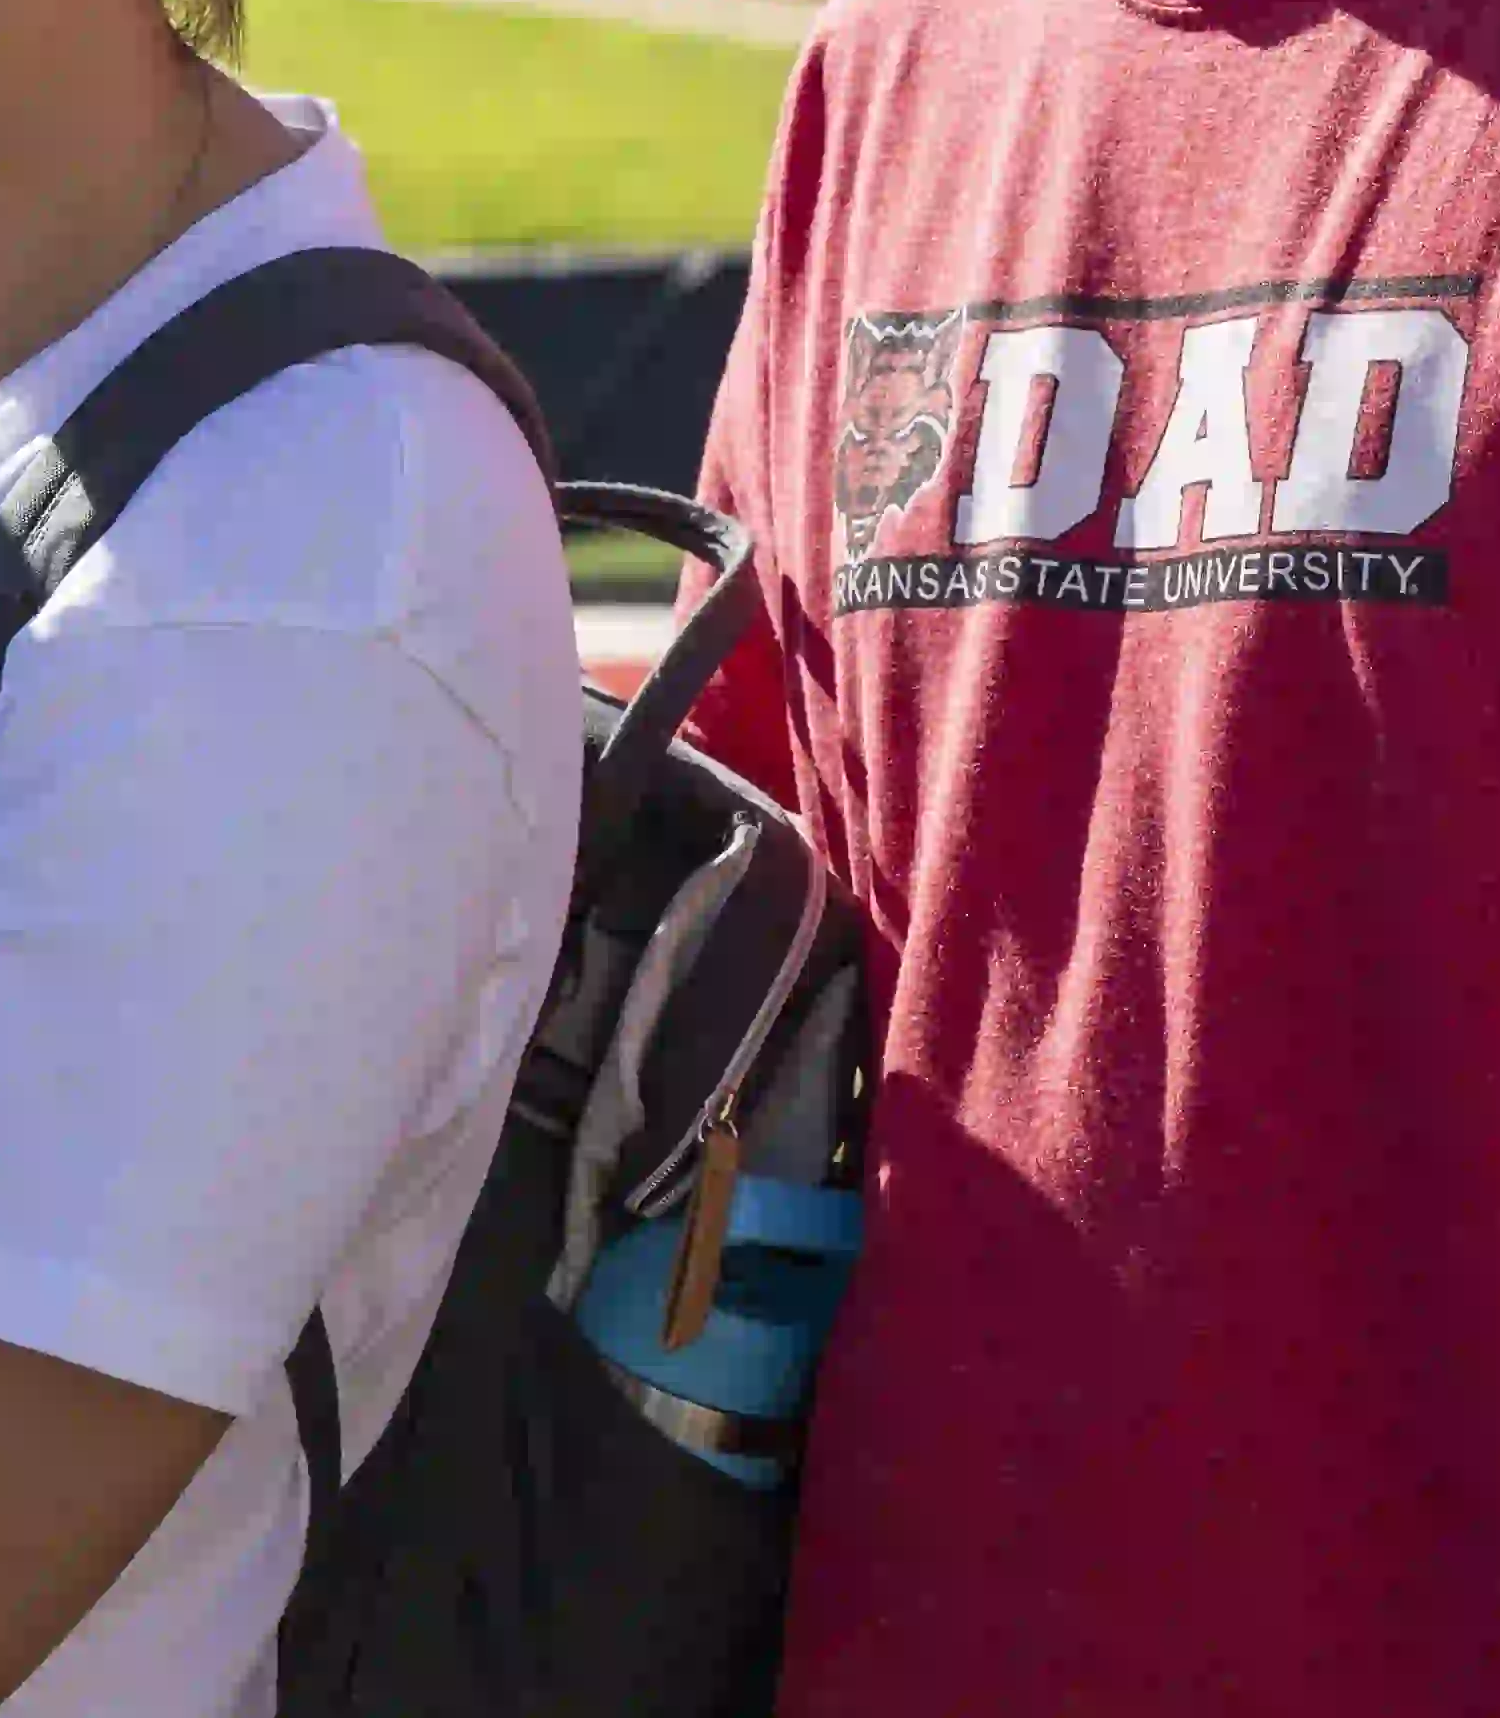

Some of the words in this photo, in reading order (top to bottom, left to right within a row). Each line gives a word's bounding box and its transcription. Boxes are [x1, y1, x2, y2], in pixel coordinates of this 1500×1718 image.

[953, 308, 1471, 552] DAD
[833, 559, 989, 612] RKANSAS
[994, 554, 1150, 607] STATE
